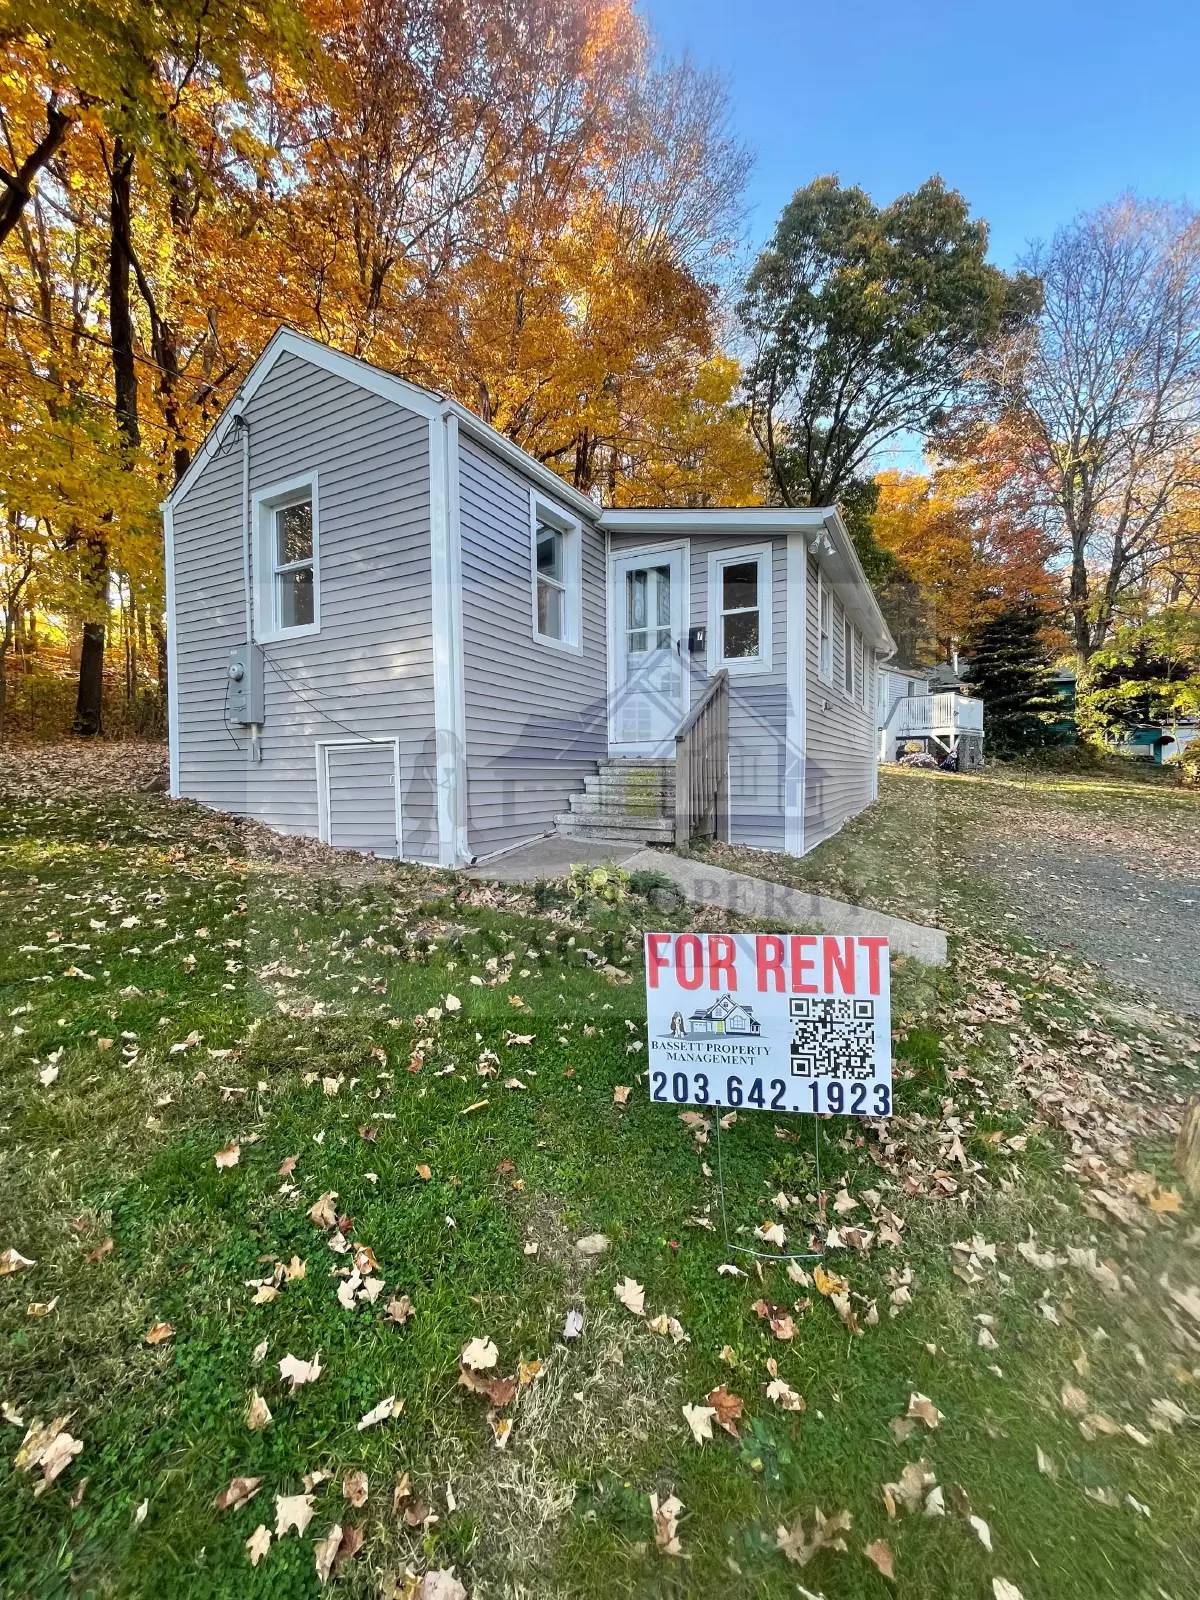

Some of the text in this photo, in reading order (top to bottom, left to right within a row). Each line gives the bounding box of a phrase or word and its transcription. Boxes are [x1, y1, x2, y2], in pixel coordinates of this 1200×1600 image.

[647, 934, 889, 995] FOR RENT
[651, 1040, 772, 1056] BASSETT PROPERTY
[666, 1052, 756, 1066] MANAGEMENT
[652, 1071, 890, 1116] 203.642.1923
